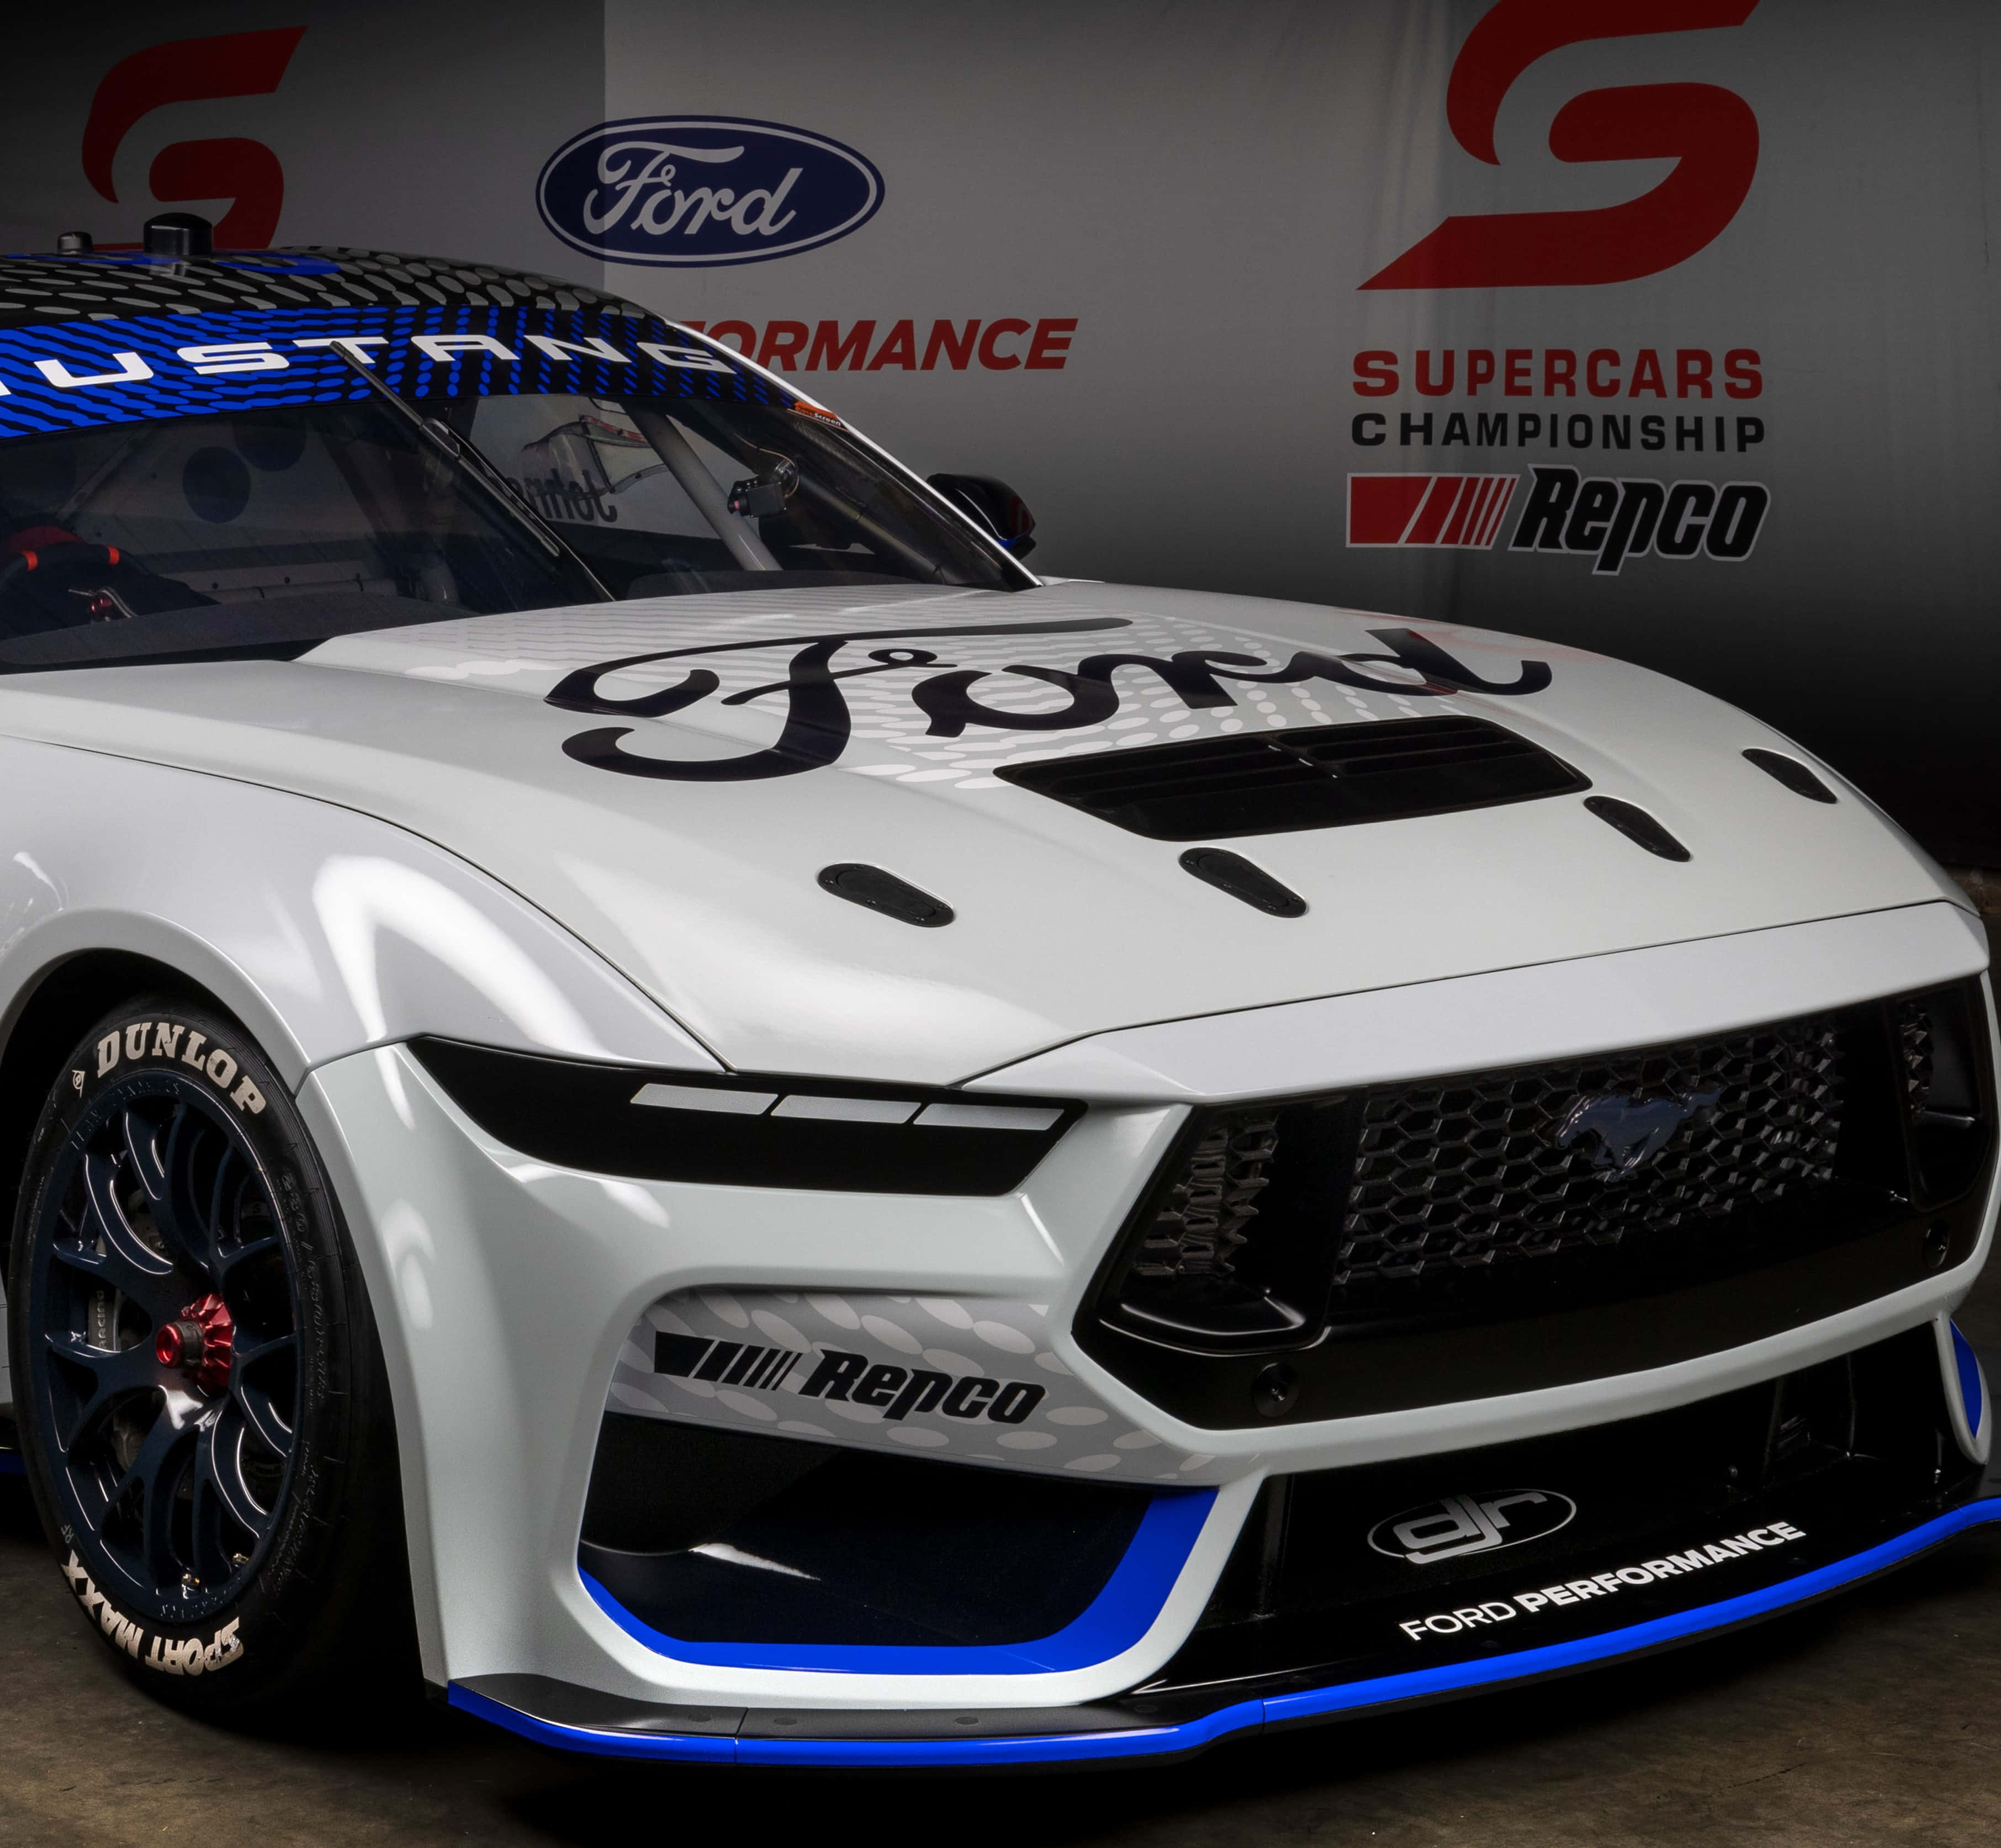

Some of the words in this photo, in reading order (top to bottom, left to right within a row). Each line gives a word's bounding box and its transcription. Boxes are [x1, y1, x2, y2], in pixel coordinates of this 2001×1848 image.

[583, 141, 803, 236] Ford
[0, 334, 738, 396] USTANG
[679, 318, 1078, 372] ORMANCE
[1352, 348, 1763, 399] SUPERCARS
[1352, 412, 1765, 452] CHAMPIONSHIP
[1508, 464, 1770, 575] Repco
[543, 618, 1552, 782] Ford
[97, 1021, 267, 1115] DUNLOP
[798, 1349, 1046, 1425] Repco
[61, 1549, 144, 1661] MAXX
[1399, 1601, 1517, 1641] FORD
[1513, 1521, 1807, 1613] PERFORMANCE
[144, 1616, 245, 1677] SPORT
